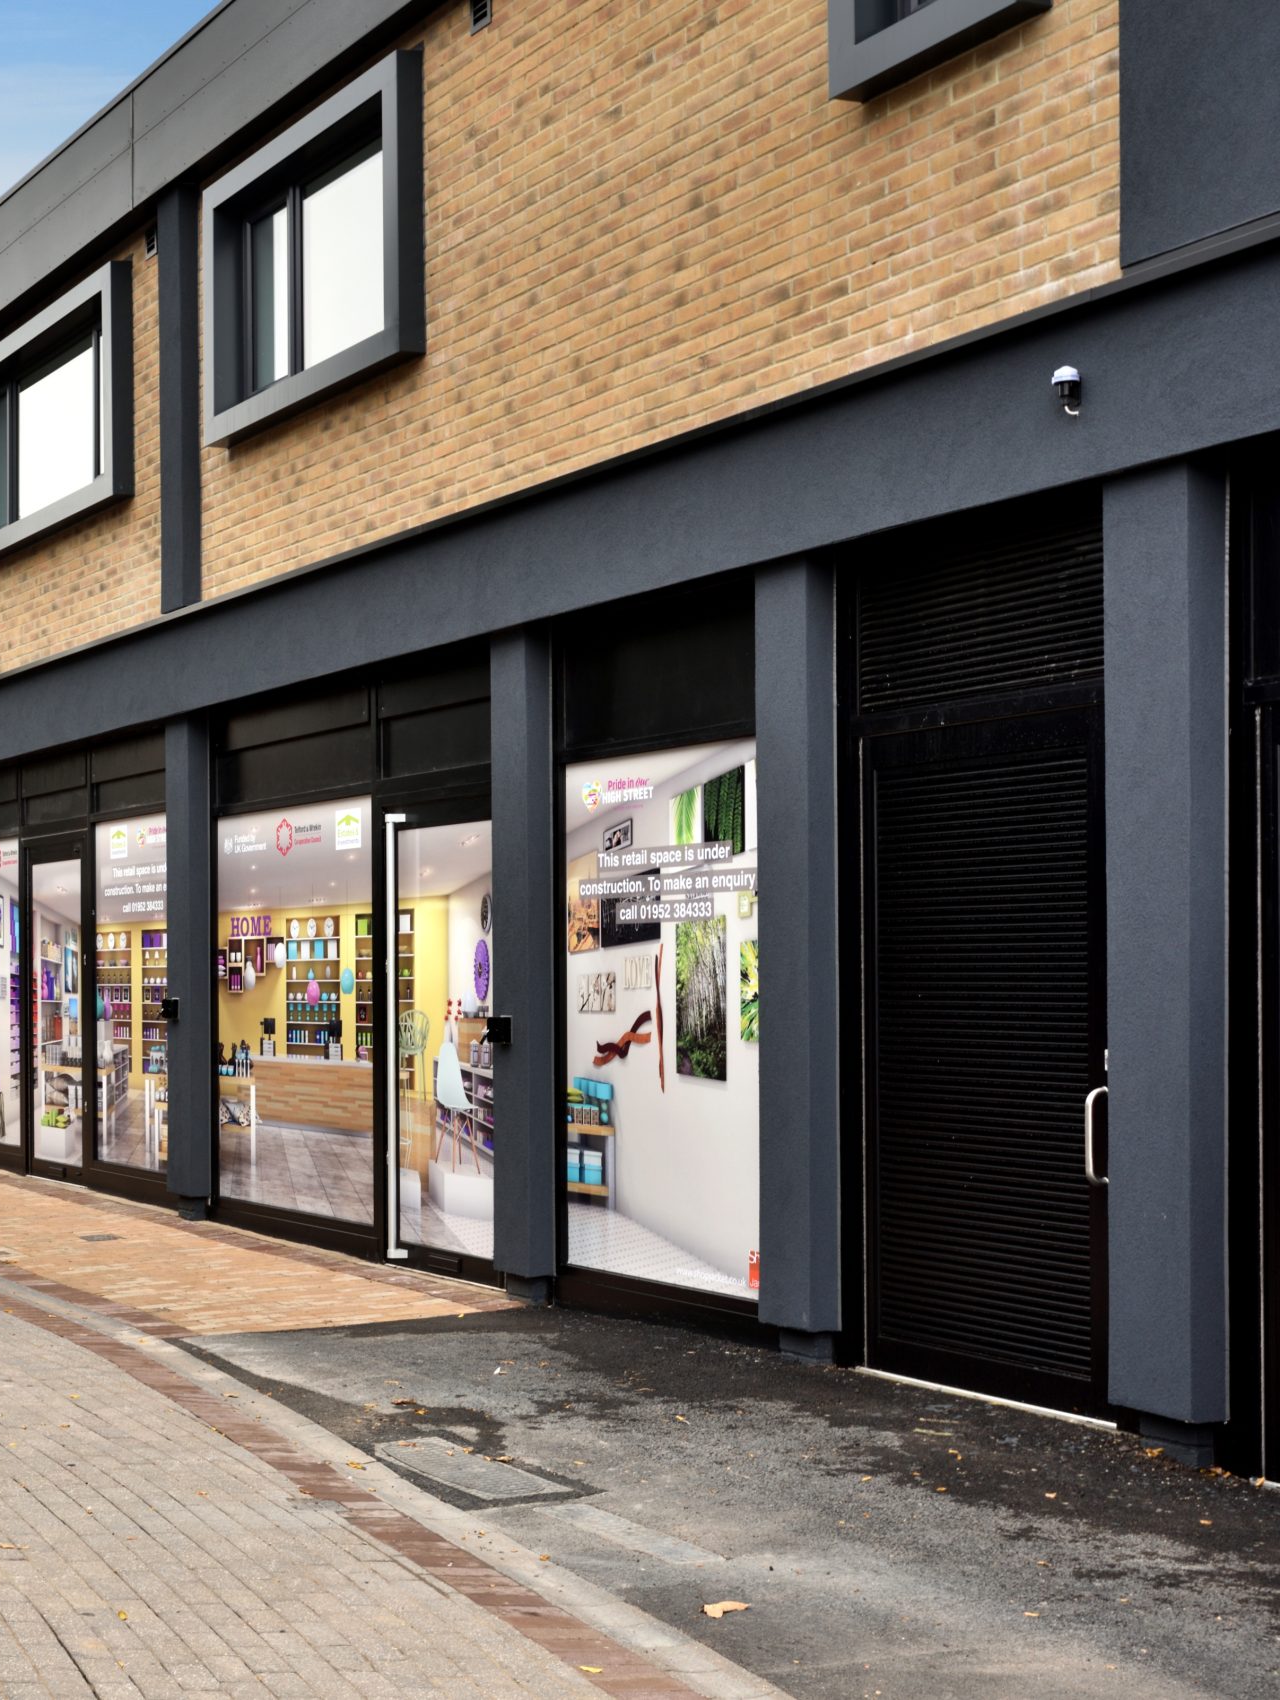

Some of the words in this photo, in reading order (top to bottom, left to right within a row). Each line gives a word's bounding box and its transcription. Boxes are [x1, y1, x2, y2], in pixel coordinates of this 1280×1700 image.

[607, 779, 626, 790] Pride
[627, 777, 635, 789] in
[602, 789, 621, 805] HIGH
[623, 786, 654, 802] STREET
[598, 852, 619, 868] This
[622, 849, 648, 866] retail
[650, 850, 682, 867] space
[684, 846, 694, 861] is
[697, 845, 731, 860] under
[113, 868, 123, 878] This
[124, 866, 136, 876] retail
[136, 866, 150, 877] space
[152, 865, 156, 873] is
[104, 885, 135, 897] construction.
[135, 883, 142, 894] To
[143, 884, 155, 894] make
[155, 884, 163, 892] an
[580, 879, 645, 896] construction.
[648, 877, 661, 891] To
[664, 874, 692, 890] make
[695, 875, 710, 888] an
[712, 871, 756, 891] enquiry
[123, 903, 131, 913] call
[132, 901, 146, 912] 01952
[147, 900, 164, 911] 384333
[620, 907, 638, 921] call
[640, 904, 671, 919] 01952
[673, 901, 712, 918] 384333
[230, 915, 273, 937] HOME
[624, 956, 652, 989] LOVE
